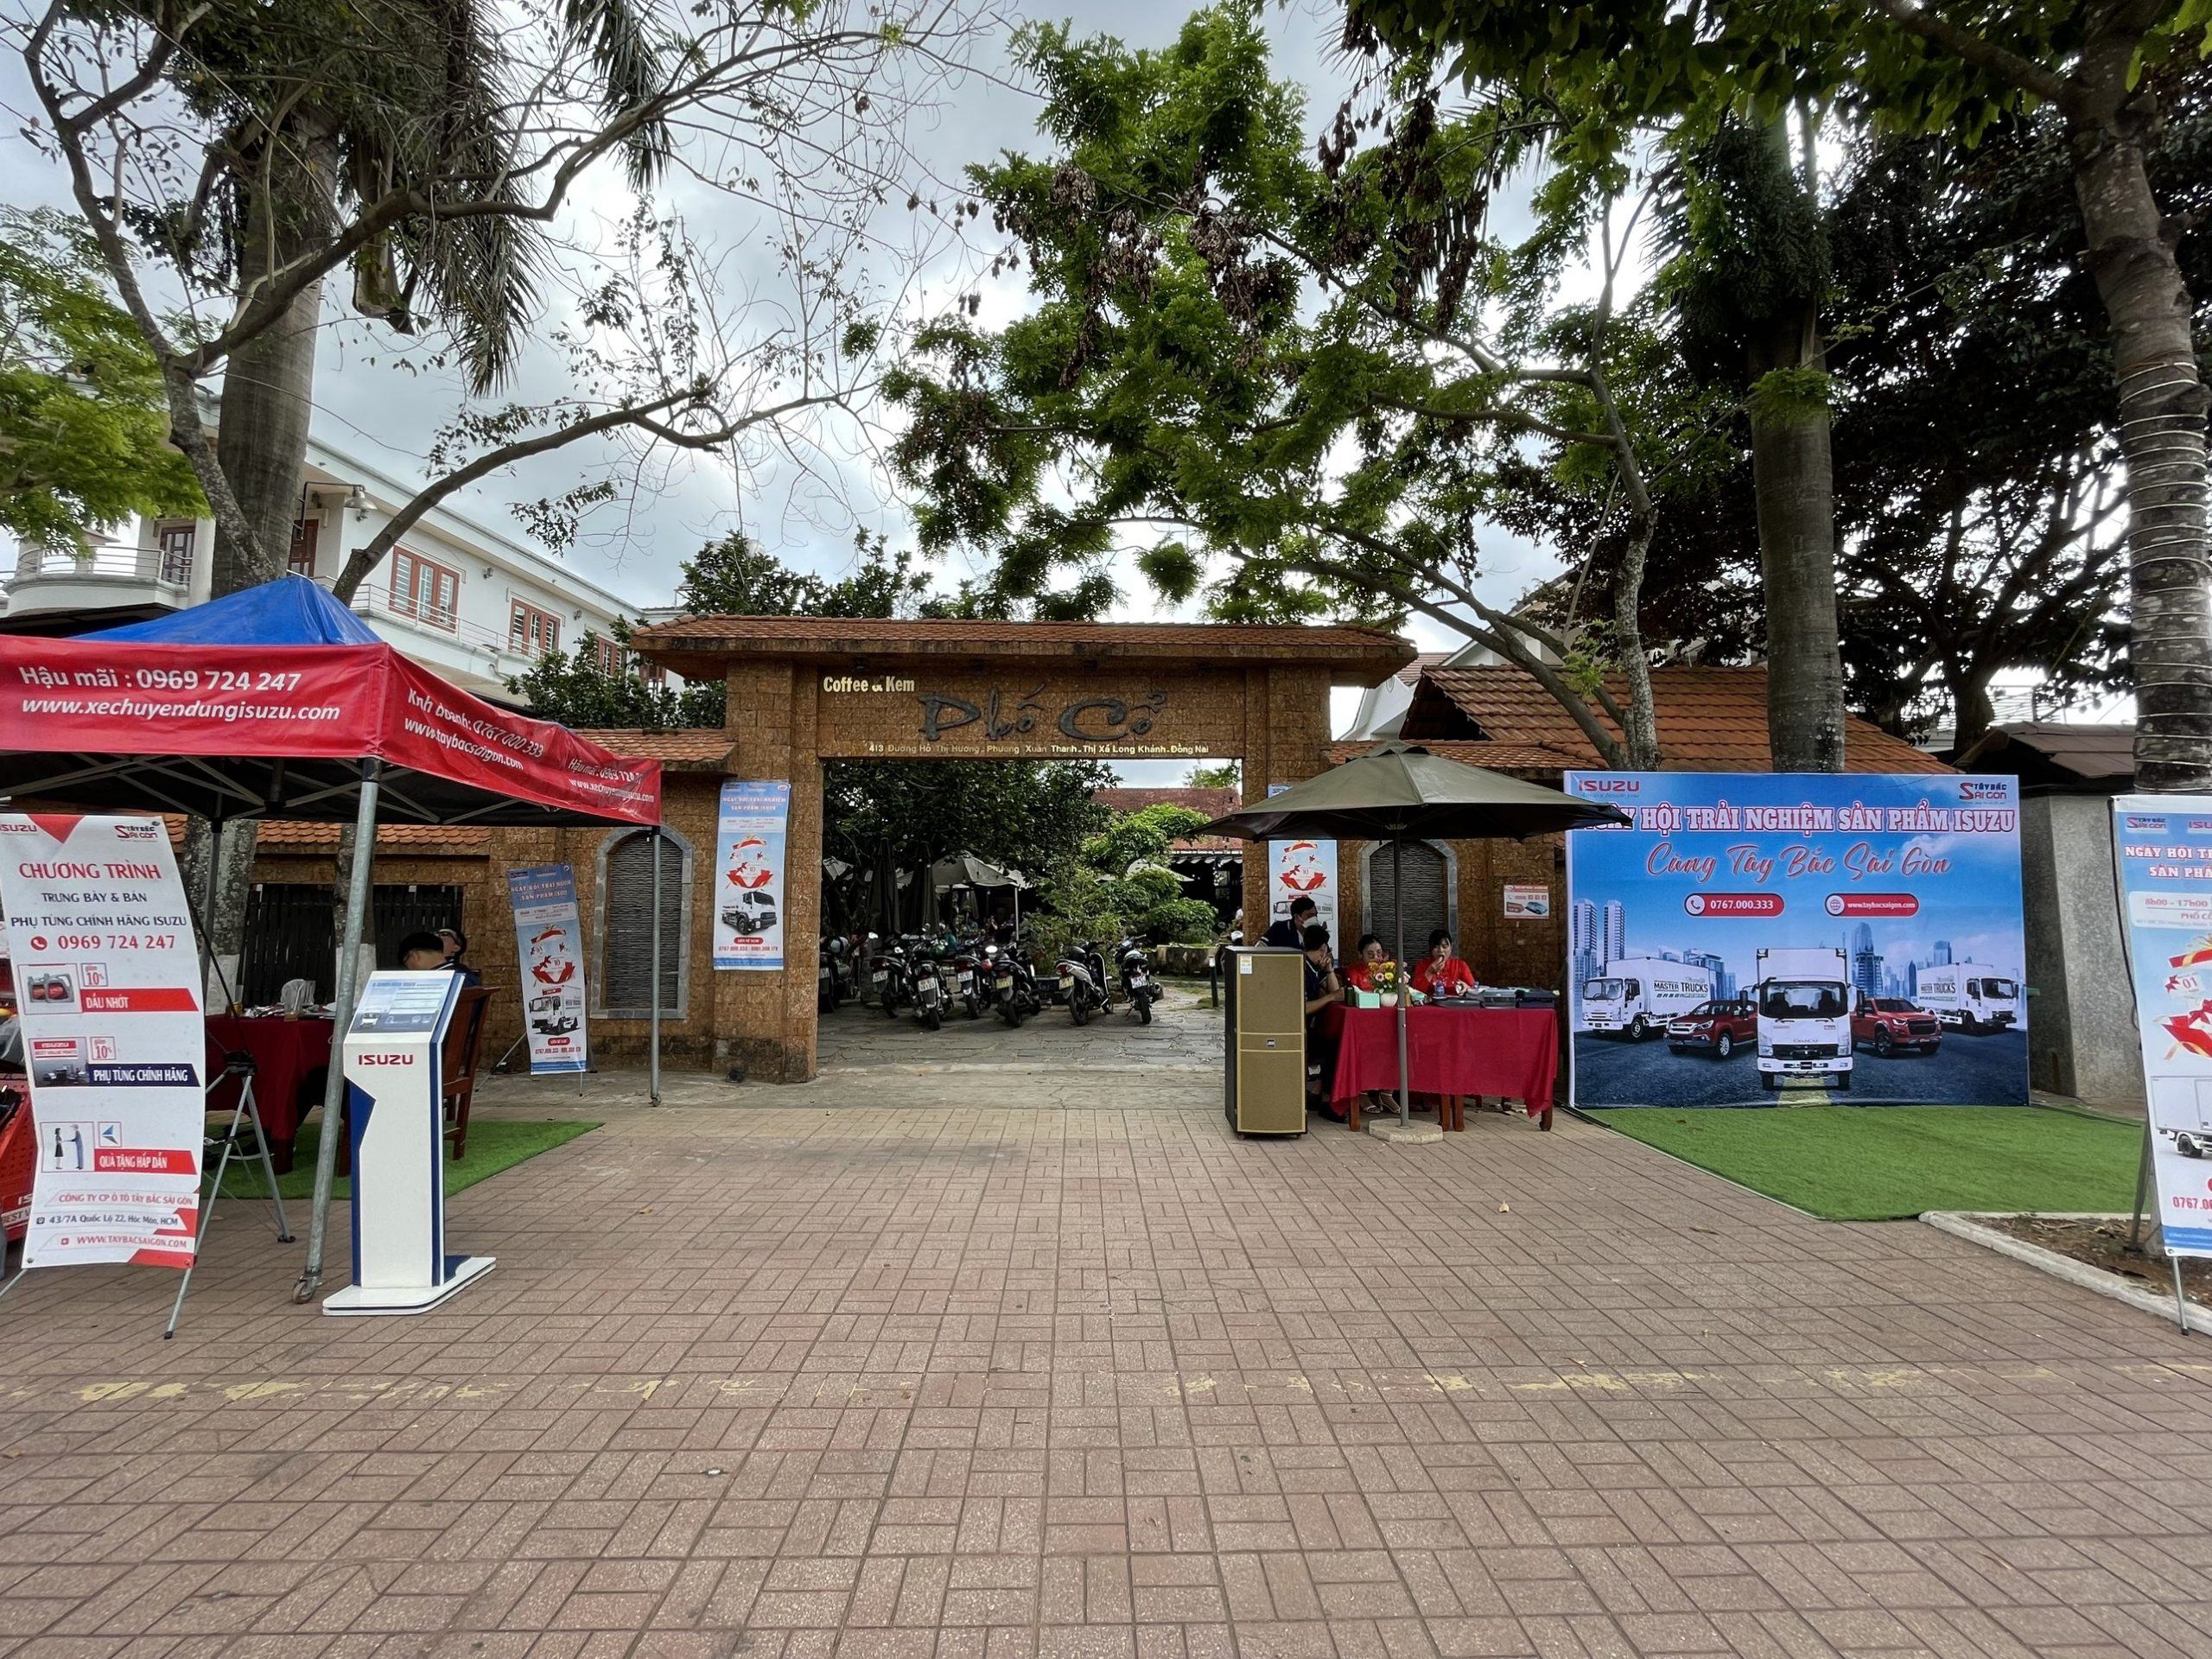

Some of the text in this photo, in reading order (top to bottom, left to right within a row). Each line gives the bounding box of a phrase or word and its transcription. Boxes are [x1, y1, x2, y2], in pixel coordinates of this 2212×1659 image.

[18, 666, 69, 690] Hậu
[76, 668, 118, 688] mãi
[136, 668, 199, 690] 0969
[204, 671, 251, 691] 724
[256, 672, 302, 692] 247
[823, 677, 868, 691] Coffee
[886, 676, 915, 691] Kem
[22, 696, 340, 722] www.xechuyendungisuzu.com
[918, 683, 1166, 741] Phố Cổ
[501, 734, 527, 750] 000
[522, 741, 543, 758] 333
[869, 744, 884, 753] 413
[1051, 745, 1077, 753] Thanh
[1083, 745, 1096, 754] Thị
[1112, 745, 1135, 754] Long
[1138, 744, 1166, 753] Khánh
[1195, 745, 1209, 753] Nai
[1579, 780, 1640, 791] ISUZU
[1641, 802, 1681, 836] HỘI
[1685, 799, 1740, 831] TRẢI
[1745, 802, 1834, 836] NGHIỆM
[1838, 800, 1884, 831] SẢN
[1887, 799, 1948, 832] PHẨM
[1953, 808, 2016, 833] ISUZU
[0, 823, 38, 833] SUZU
[2167, 844, 2192, 861] HỘI
[1646, 842, 1952, 884] Cùng Tây Bắc Sài Gòn
[19, 860, 162, 880] CHƯƠNG TRÌNH
[111, 893, 119, 902] &
[1710, 900, 1774, 910] 0767.000.333
[1847, 901, 1916, 911] www.taybacsaigon.com
[11, 917, 38, 929] PHỤ
[153, 916, 187, 926] ISUZU
[58, 935, 175, 950] 0969 724 247
[1681, 982, 1708, 993] TRUCKS
[1934, 982, 1956, 994] TRUCKS
[2183, 977, 2198, 988] 01
[359, 1054, 414, 1065] ISUZU
[93, 1070, 111, 1084] PHỤ
[137, 1067, 162, 1081] CHÍNH
[49, 1215, 77, 1224] 43/7A
[79, 1214, 100, 1223] Quốc
[104, 1214, 112, 1224] Lộ
[160, 1217, 178, 1225] HCM
[77, 1236, 187, 1249] WWW.TAYBACSAIGON.COM
